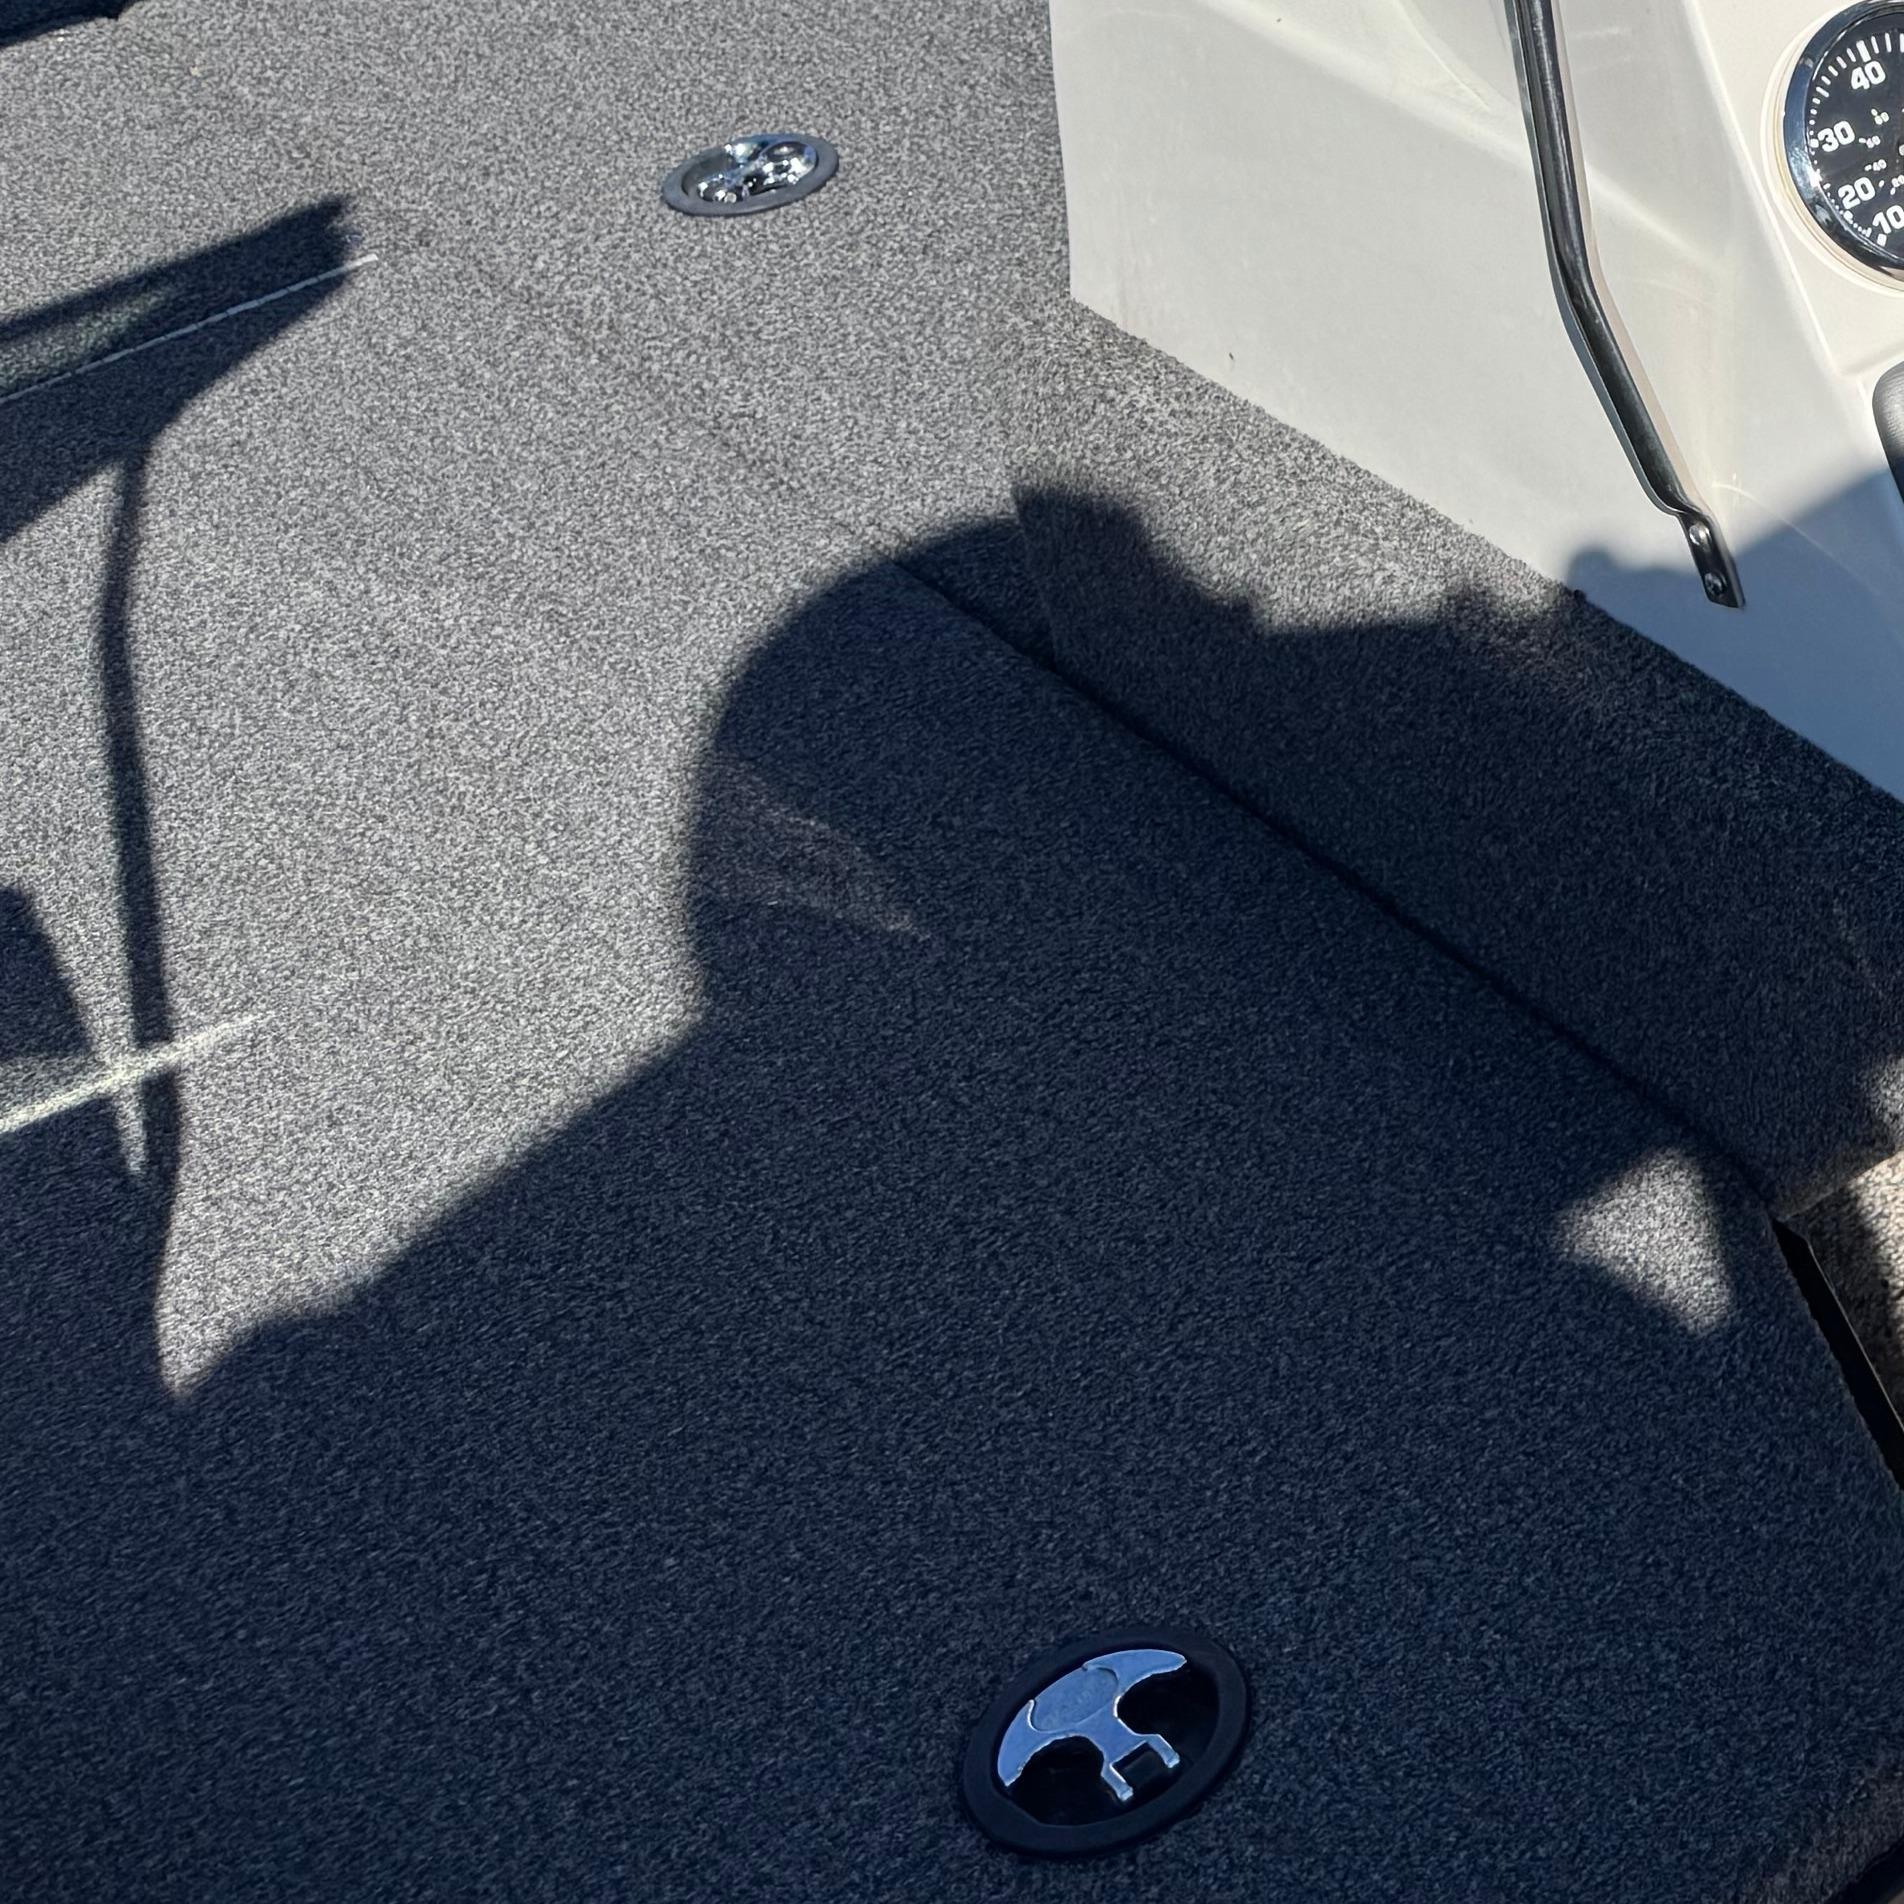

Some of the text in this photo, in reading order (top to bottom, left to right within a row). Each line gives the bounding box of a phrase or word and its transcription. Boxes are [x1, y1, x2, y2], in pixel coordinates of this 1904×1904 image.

[1850, 60, 1886, 90] 40
[1817, 120, 1856, 153] 30
[1838, 177, 1876, 210] 20
